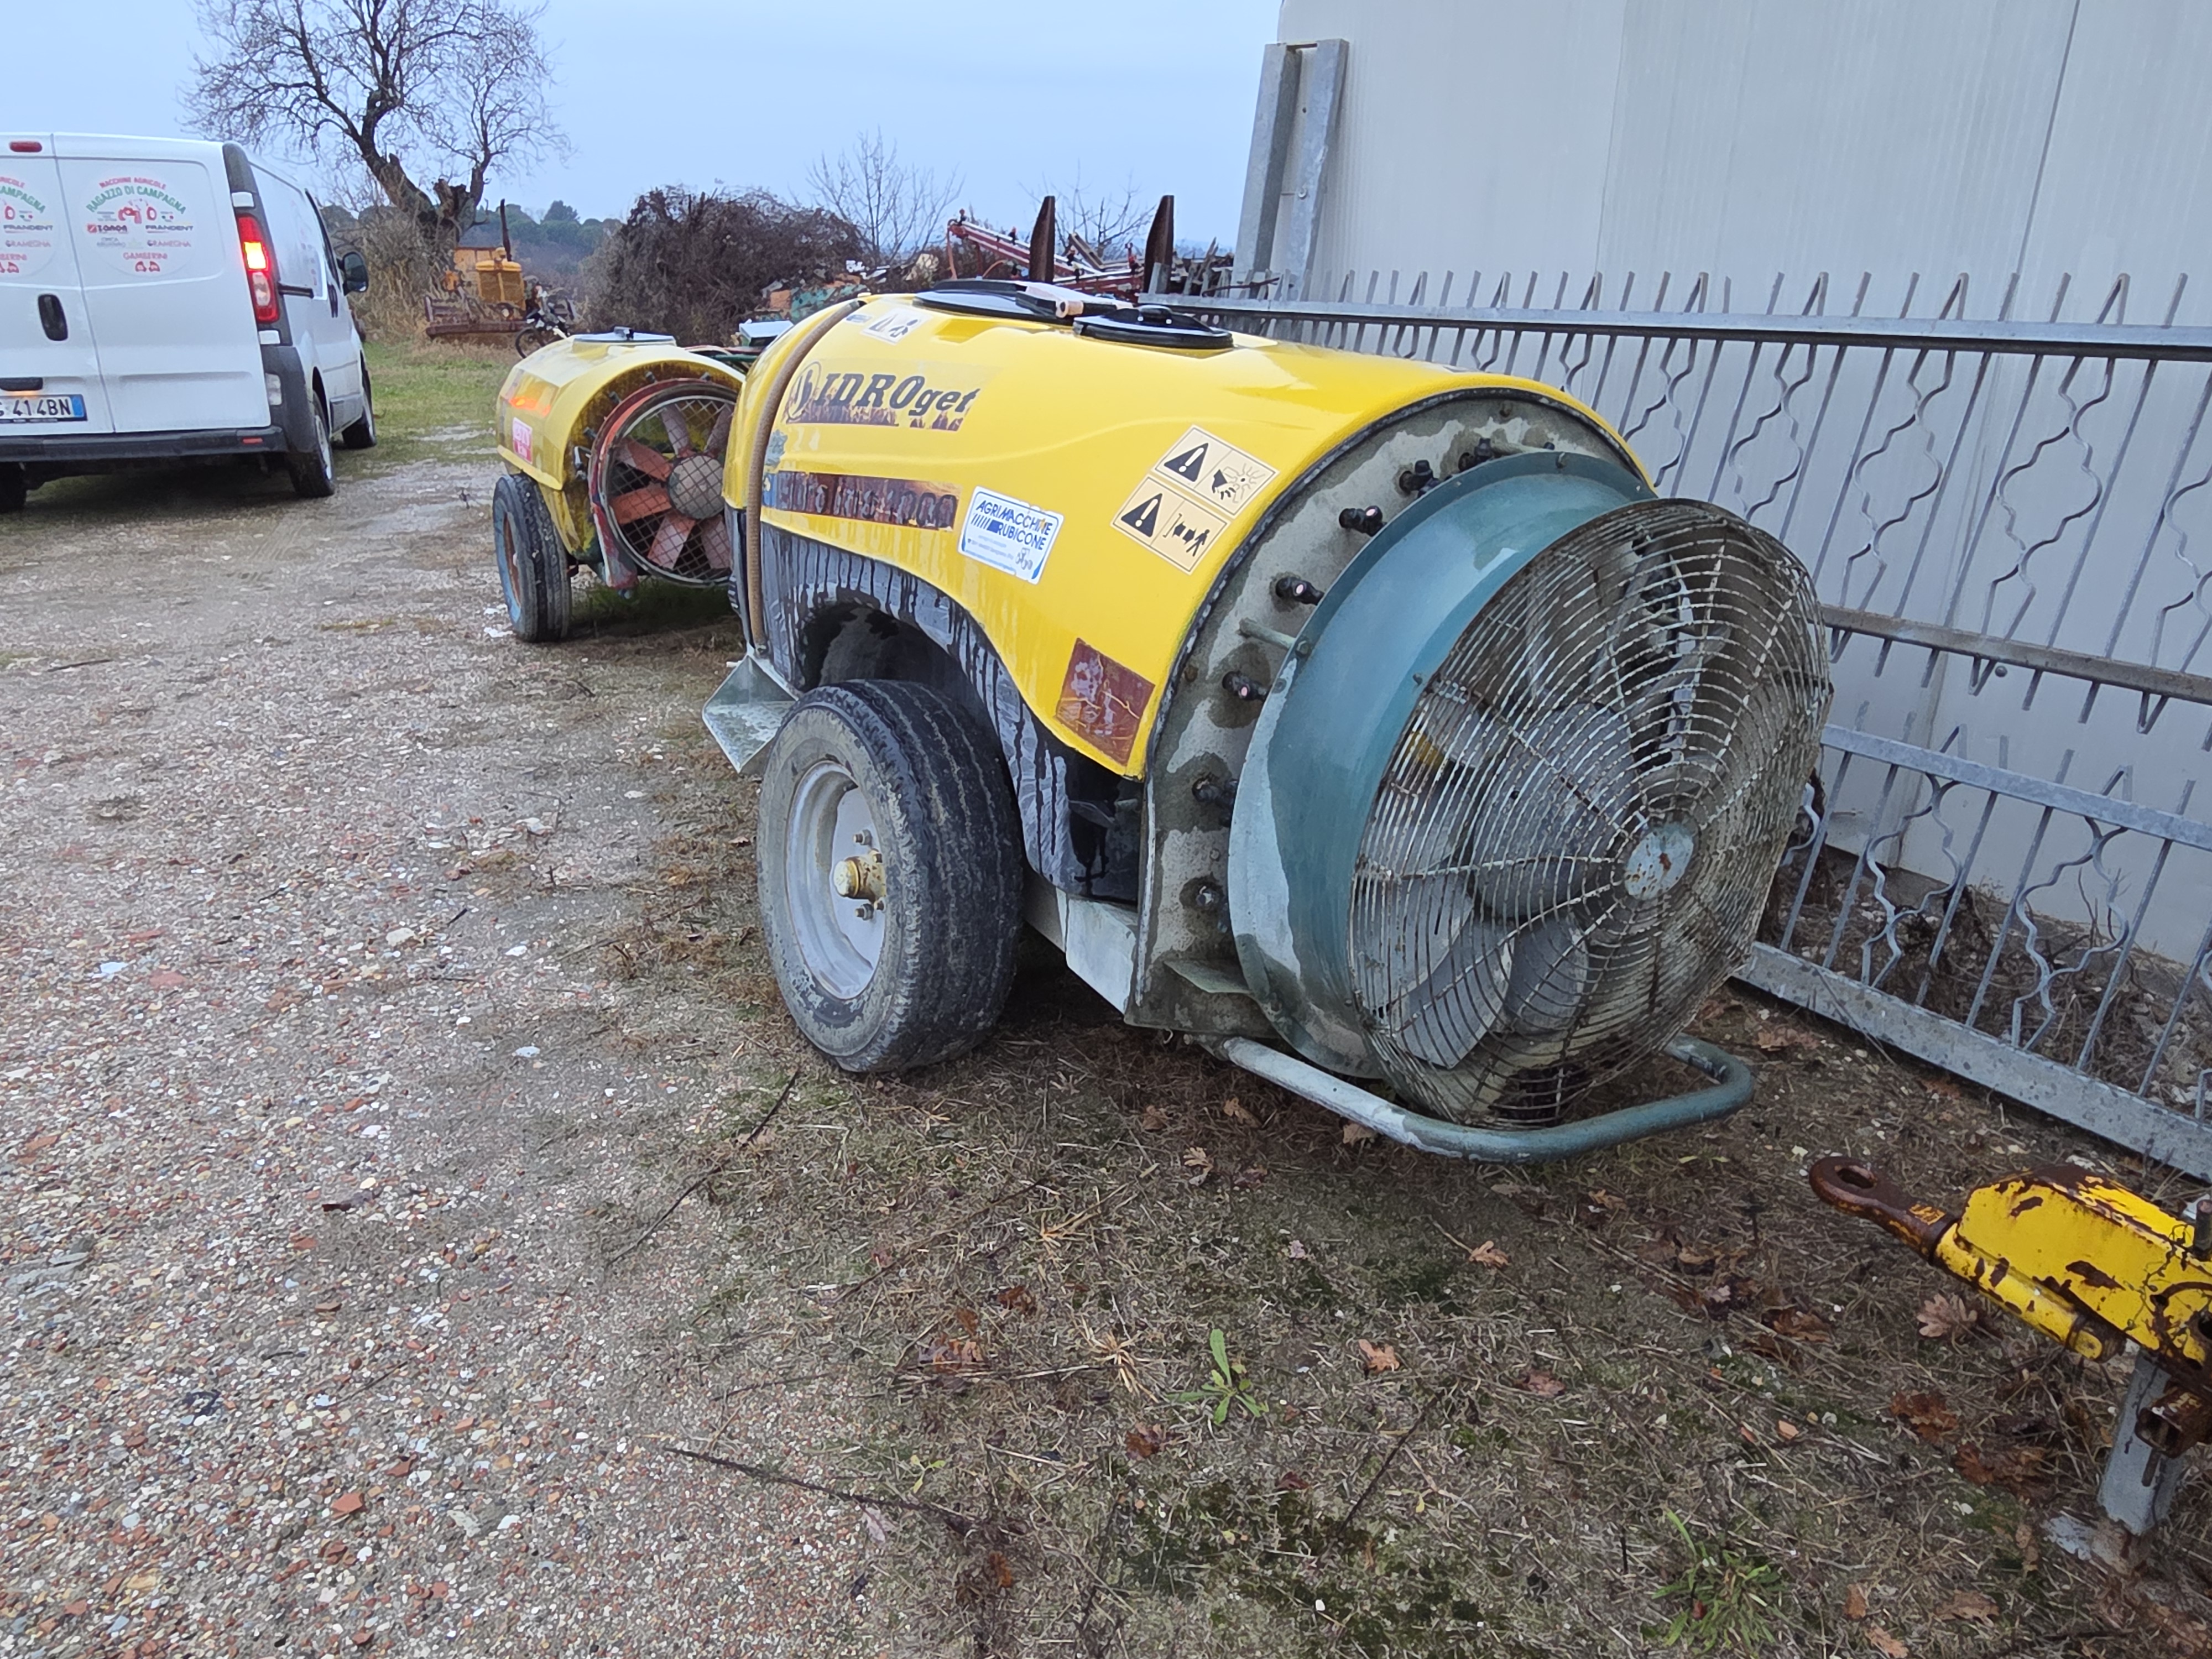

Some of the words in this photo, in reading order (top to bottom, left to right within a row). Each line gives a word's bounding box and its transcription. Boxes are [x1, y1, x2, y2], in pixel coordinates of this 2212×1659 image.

[134, 177, 166, 190] AGRICOLE
[0, 185, 46, 213] AMPAGNA
[86, 186, 123, 213] RAGAZZO
[124, 185, 135, 195] DI
[137, 186, 186, 215] CAMPAGNA
[975, 500, 1053, 536] AGRIMACCHINE
[996, 522, 1047, 551] RUBICONE
